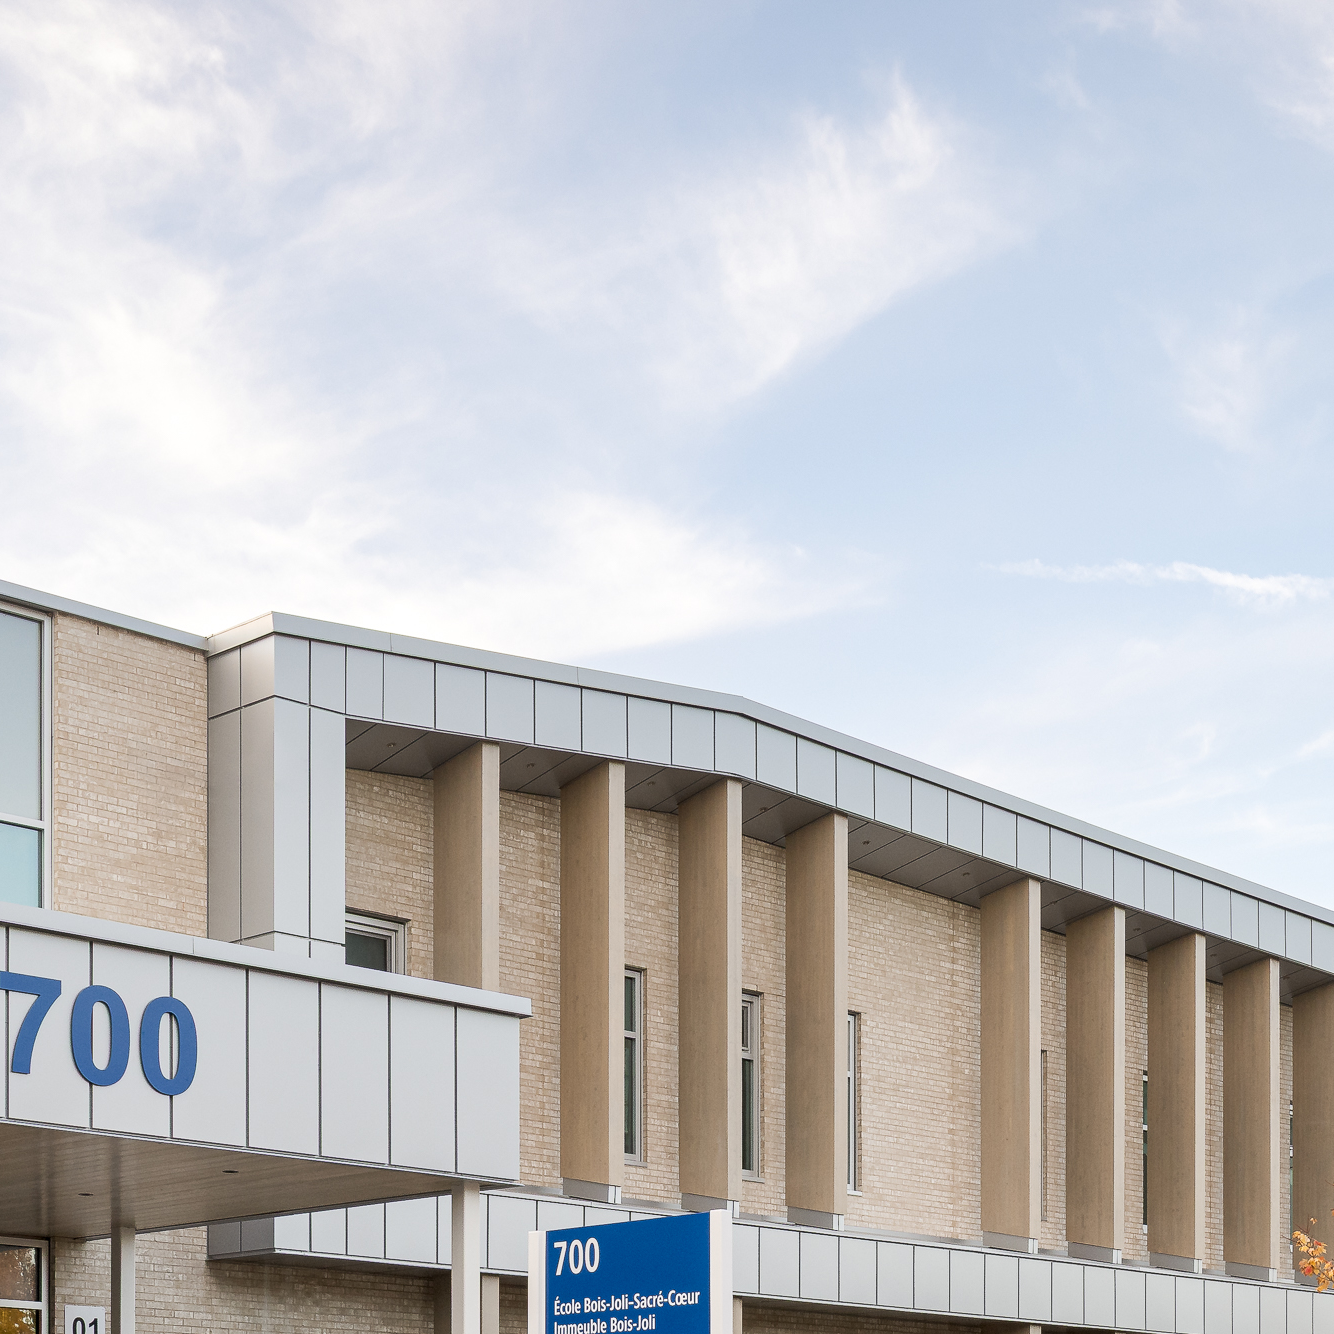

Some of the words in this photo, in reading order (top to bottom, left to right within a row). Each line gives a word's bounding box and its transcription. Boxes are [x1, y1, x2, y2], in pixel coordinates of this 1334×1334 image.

[554, 1237, 600, 1276] 700
[554, 1296, 581, 1316] École
[610, 1314, 656, 1333] Bois-Joli
